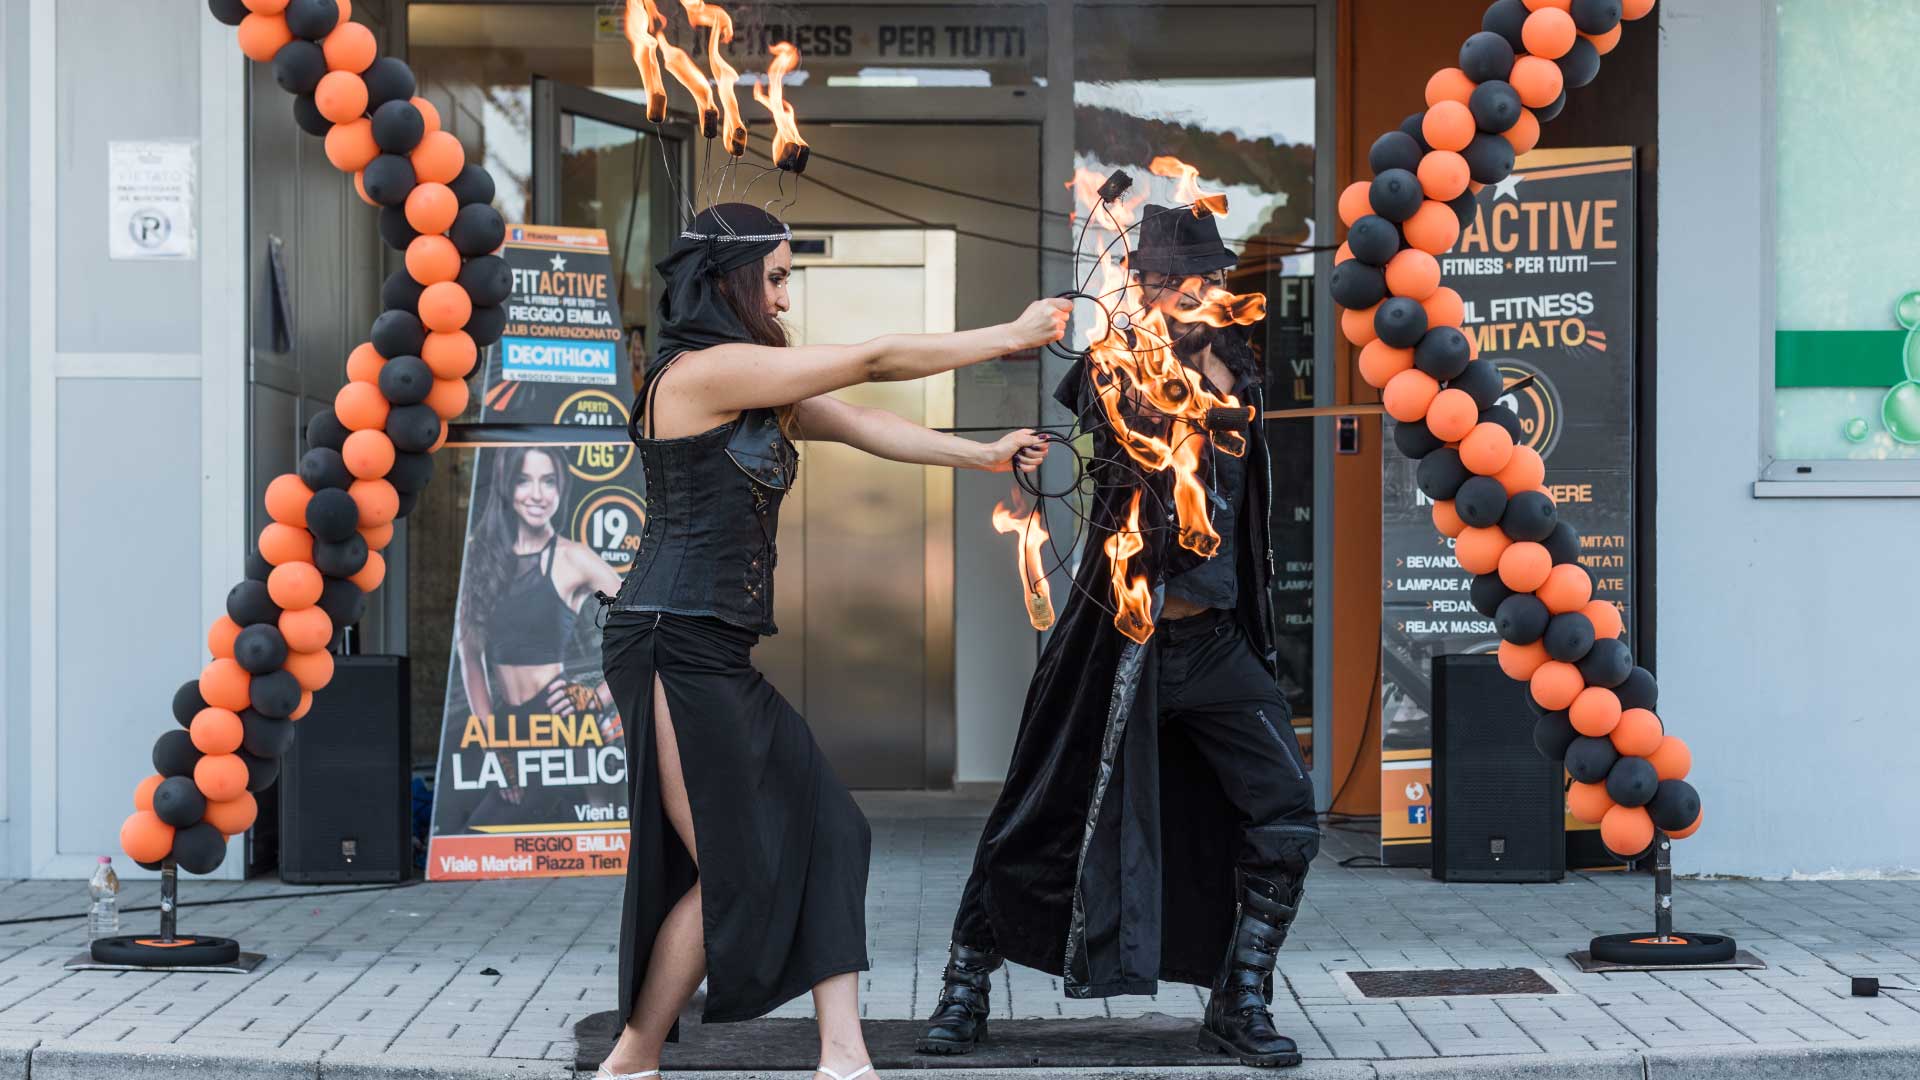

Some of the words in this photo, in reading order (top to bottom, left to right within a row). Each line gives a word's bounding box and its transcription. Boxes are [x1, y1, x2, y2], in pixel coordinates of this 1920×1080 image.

[728, 24, 852, 56] FITNESS
[878, 26, 936, 57] PER
[945, 26, 1026, 57] TUTTI
[1458, 199, 1617, 253] ACTIVE
[1442, 257, 1504, 276] FITNESS
[1514, 256, 1544, 274] PER
[1547, 255, 1588, 273] TUTTI
[511, 267, 608, 299] FITACTIVE
[1280, 278, 1314, 317] FI
[1490, 291, 1594, 321] FITNESS
[509, 305, 564, 323] REGGIO
[566, 308, 612, 325] EMILIA
[530, 324, 621, 341] CONVENZIONATO
[1462, 318, 1586, 352] MITATO
[508, 344, 610, 369] DECATHLON
[1291, 359, 1314, 376] VI
[577, 400, 609, 413] APERTO
[1578, 535, 1624, 548] MITATI
[601, 550, 630, 562] euro
[1407, 556, 1461, 568] BEVAND
[1577, 555, 1623, 568] MITATI
[1397, 578, 1459, 591] LAMPADE
[1406, 621, 1448, 634] RELAX
[1451, 621, 1498, 634] MASSA
[460, 713, 604, 748] ALLENA
[452, 751, 508, 790] LA
[574, 803, 614, 821] Vieni
[514, 836, 573, 852] REGGIO
[576, 835, 626, 852] EMILIA
[440, 855, 478, 872] Viale
[481, 854, 532, 872] Martiri
[536, 854, 584, 870] Piazza
[589, 852, 622, 869] Tien
